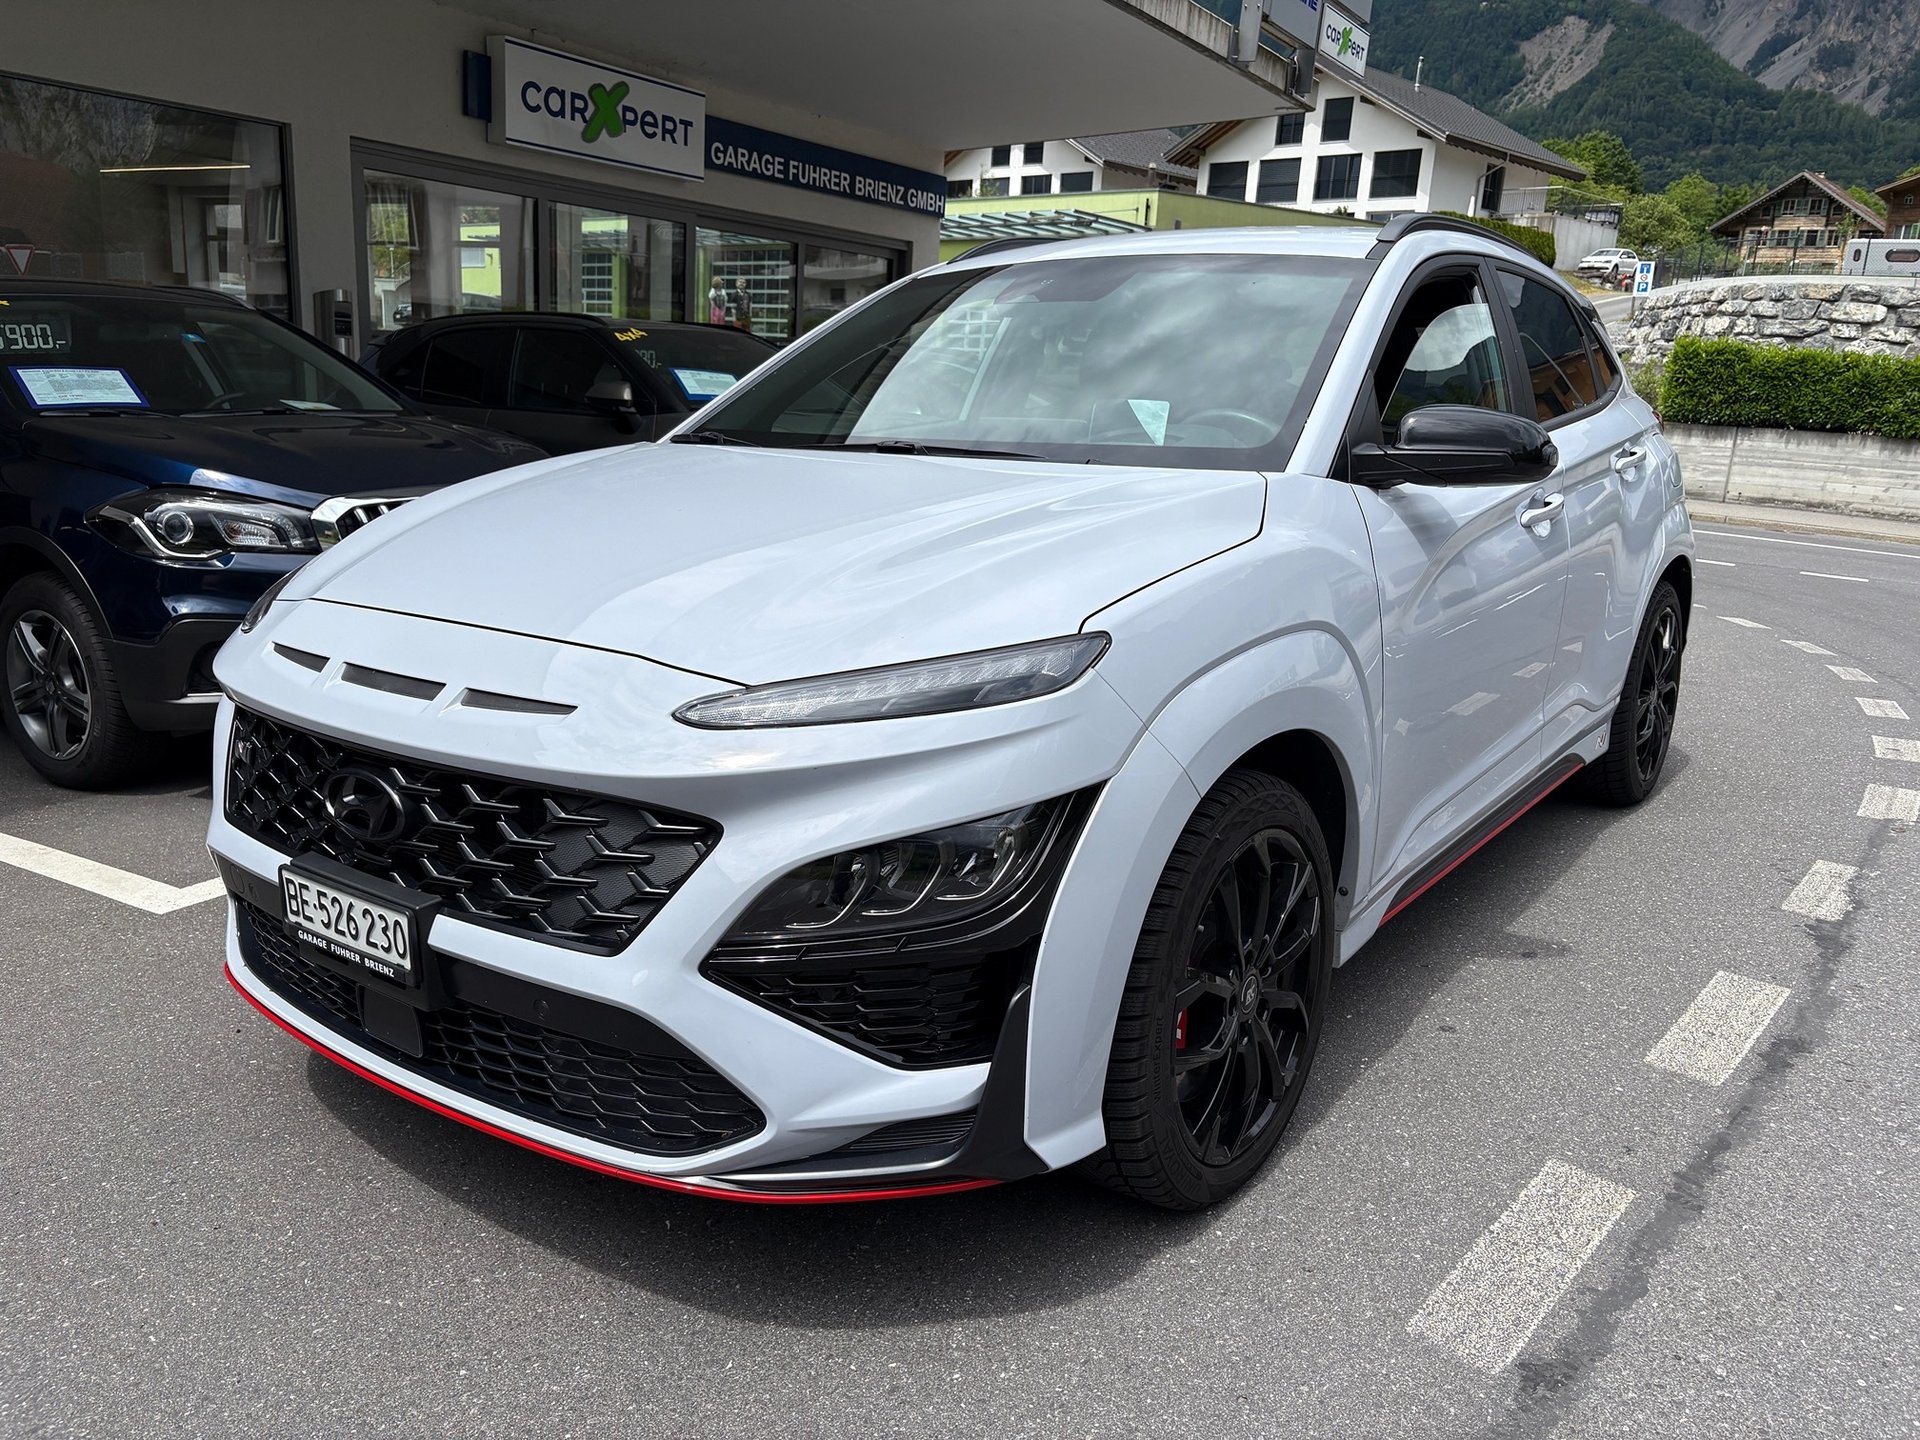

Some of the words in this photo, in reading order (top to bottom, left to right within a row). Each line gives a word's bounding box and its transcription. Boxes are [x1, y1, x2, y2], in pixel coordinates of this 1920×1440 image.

[711, 142, 785, 179] GARAGE
[789, 160, 850, 193] FUHRER
[855, 175, 905, 205] BRIENZ
[907, 188, 945, 214] GMBH
[1639, 282, 1647, 292] P
[298, 930, 328, 949] GARAGE
[331, 943, 361, 964] FUHRER
[364, 957, 395, 978] BRIENZ
[1151, 1015, 1165, 1105] WinterExpert
